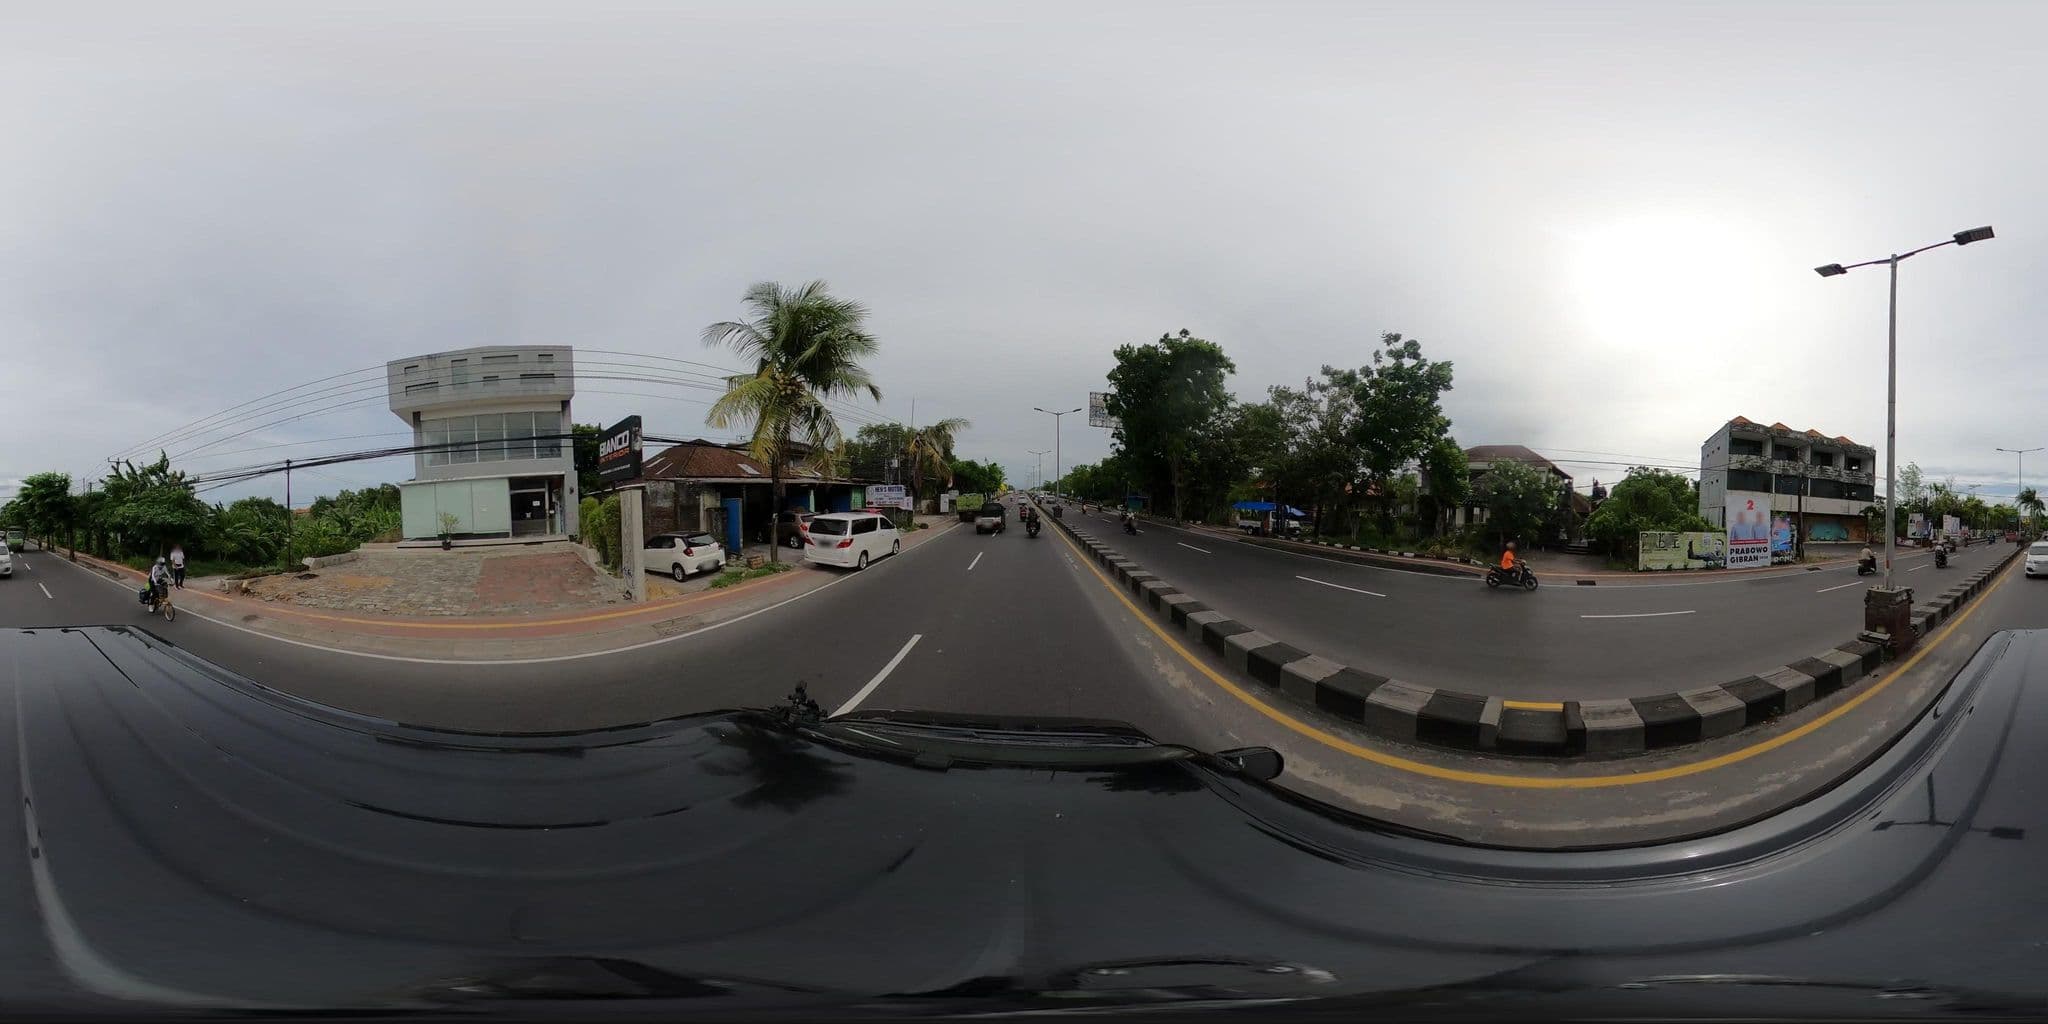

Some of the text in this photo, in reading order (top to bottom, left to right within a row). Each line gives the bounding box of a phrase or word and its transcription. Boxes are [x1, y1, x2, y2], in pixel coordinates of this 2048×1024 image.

[599, 430, 630, 457] BIANCO
[1746, 499, 1754, 510] 2
[1730, 546, 1768, 555] PRABOWO
[1730, 554, 1759, 563] GIBRAN
